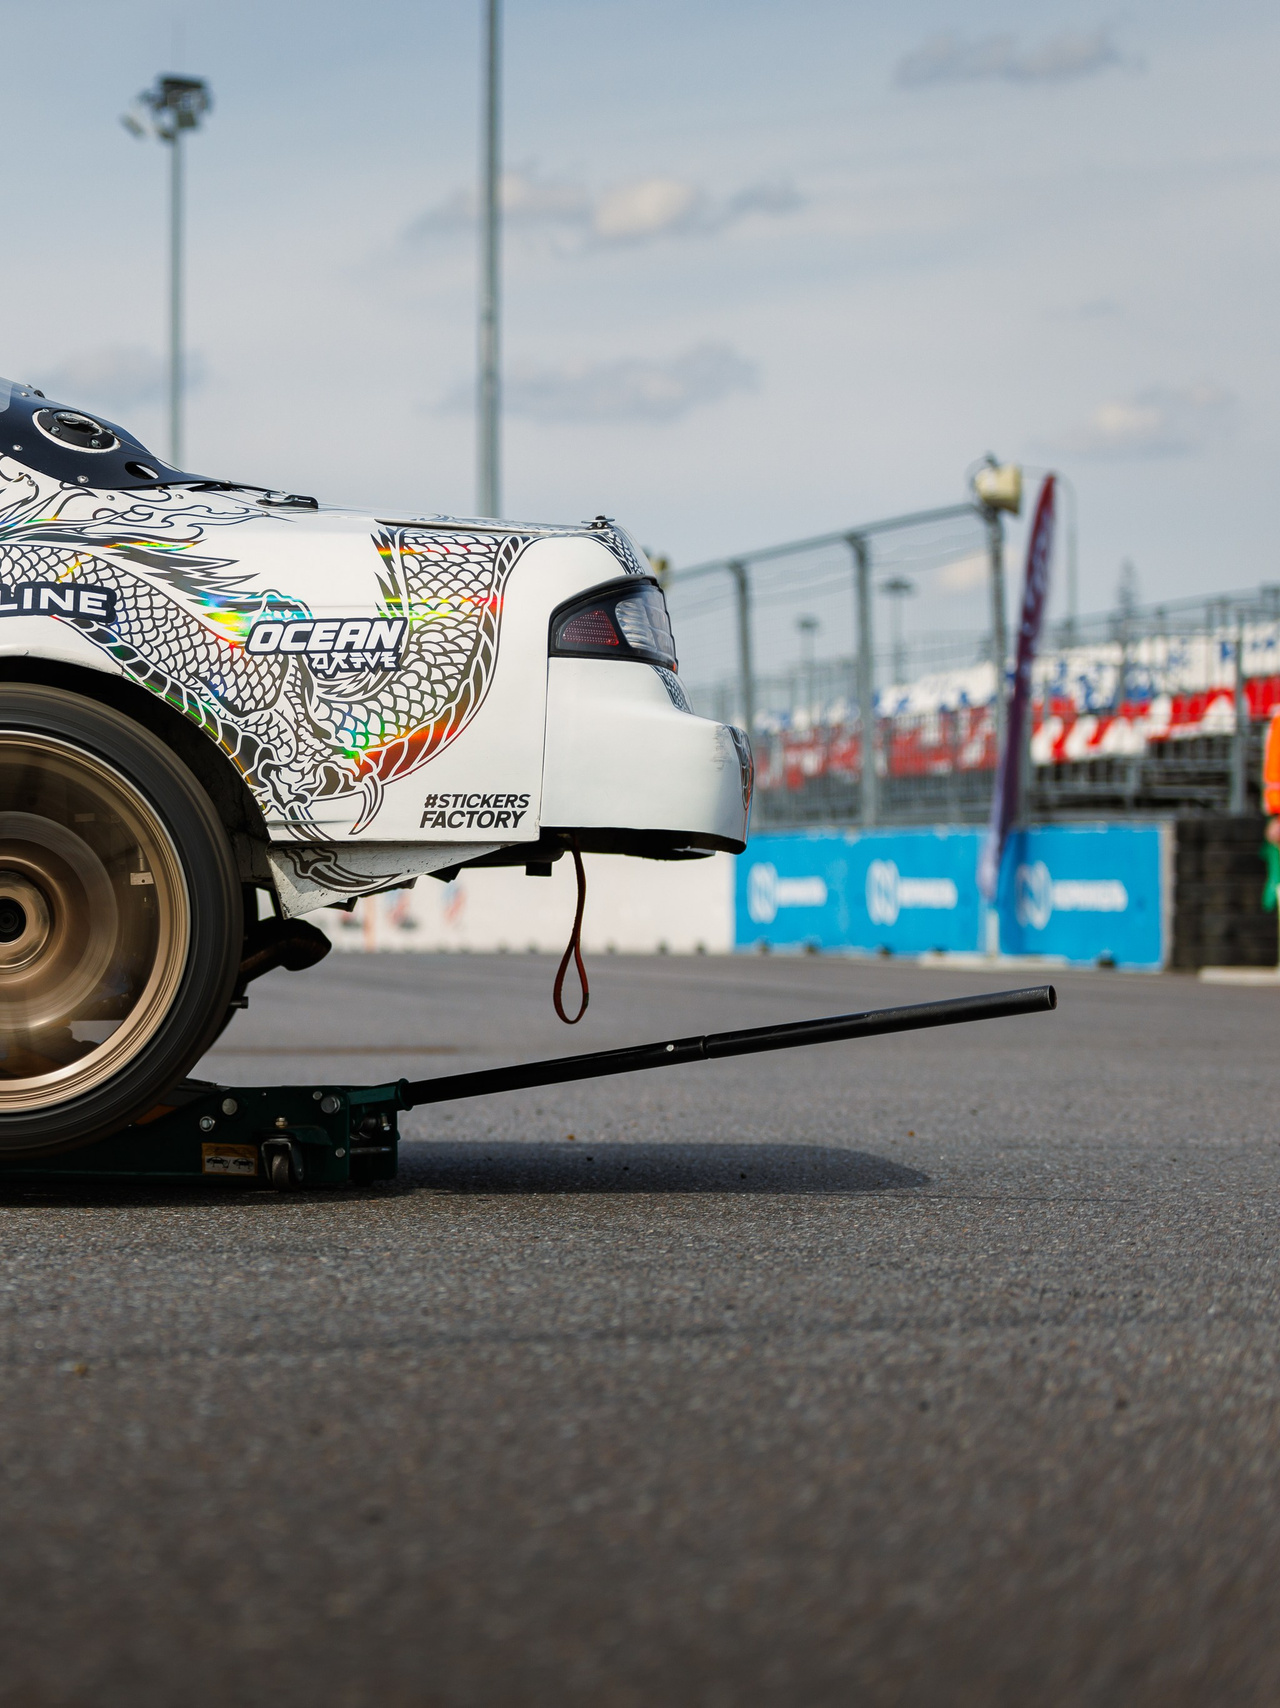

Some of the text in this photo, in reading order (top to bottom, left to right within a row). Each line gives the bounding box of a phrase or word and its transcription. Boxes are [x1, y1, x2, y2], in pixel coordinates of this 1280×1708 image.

[248, 620, 404, 652] OCEAN
[423, 793, 531, 809] #STICKERS
[419, 810, 528, 829] FACTORY
